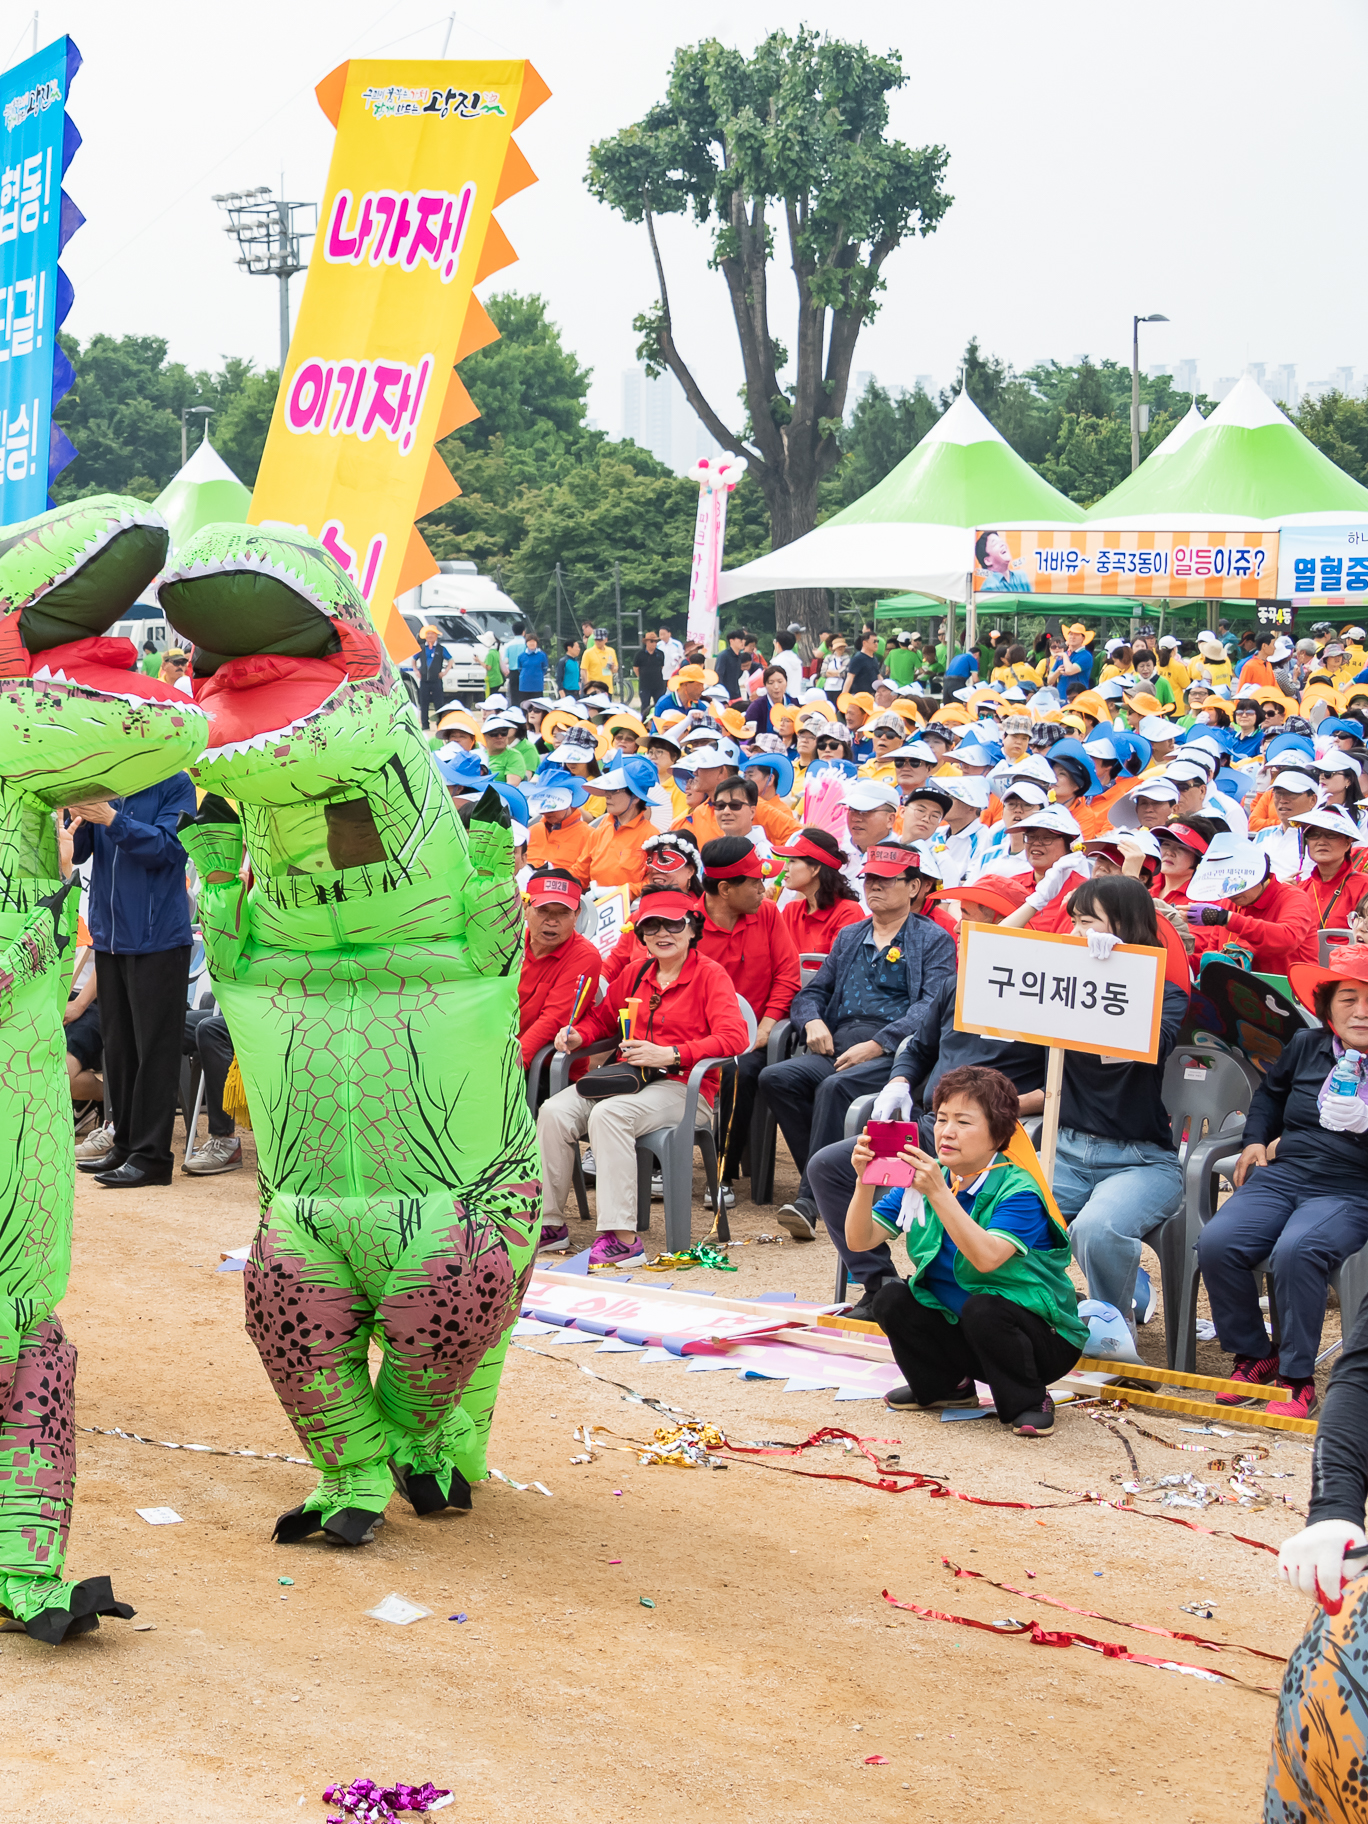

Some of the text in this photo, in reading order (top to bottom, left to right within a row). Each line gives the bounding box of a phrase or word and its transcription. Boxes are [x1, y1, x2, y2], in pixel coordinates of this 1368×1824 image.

[423, 88, 481, 118] 광진
[329, 188, 471, 277] 나가자!
[290, 360, 429, 450] 이기자!
[1035, 546, 1265, 577] 거바유~ 중곡3동이 일등이쥬?
[1257, 607, 1292, 625] 중곡4동
[546, 880, 567, 891] 구의2동
[988, 966, 1129, 1015] 구의제3동
